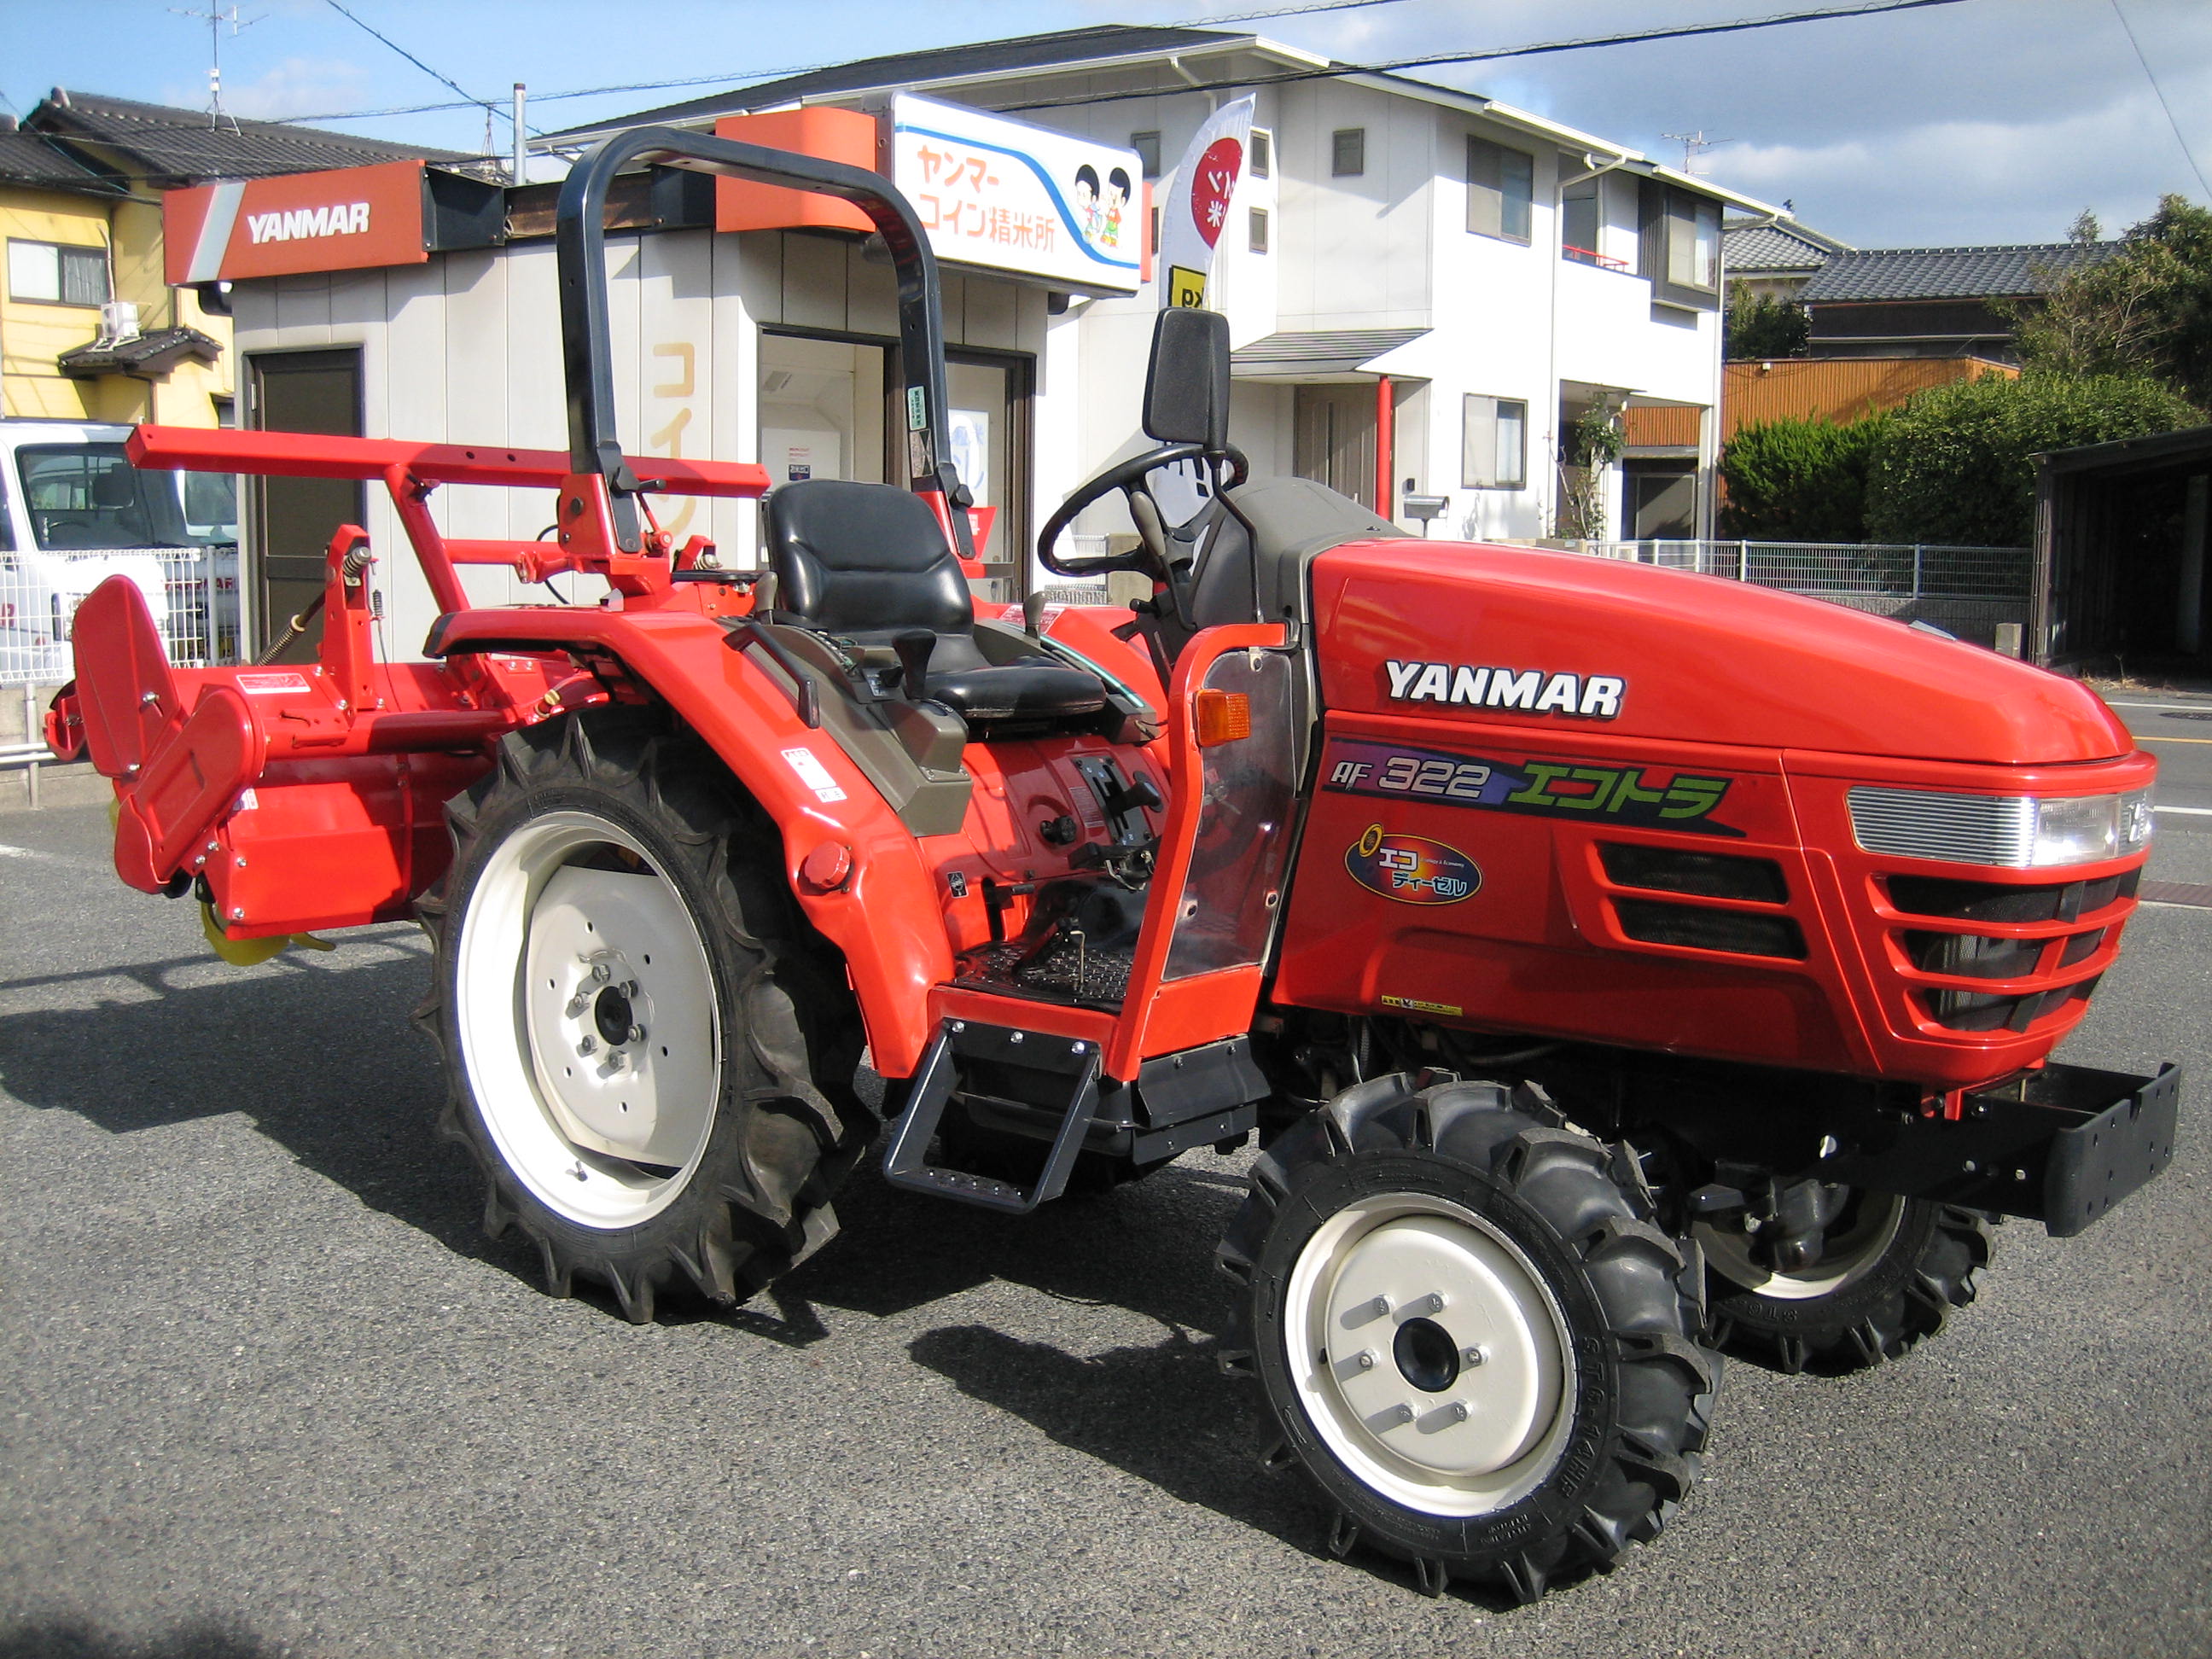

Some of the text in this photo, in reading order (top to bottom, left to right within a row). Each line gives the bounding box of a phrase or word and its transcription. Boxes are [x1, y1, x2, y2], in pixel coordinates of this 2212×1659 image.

[917, 144, 999, 193] ヤンマー
[247, 202, 370, 244] YANMAR
[919, 193, 1056, 253] コイン精米所
[1385, 660, 1625, 718] YANMAR
[1330, 757, 1728, 819] AF 322 エコトラ
[1378, 847, 1419, 871] エコ
[1392, 870, 1468, 896] ディーゼル
